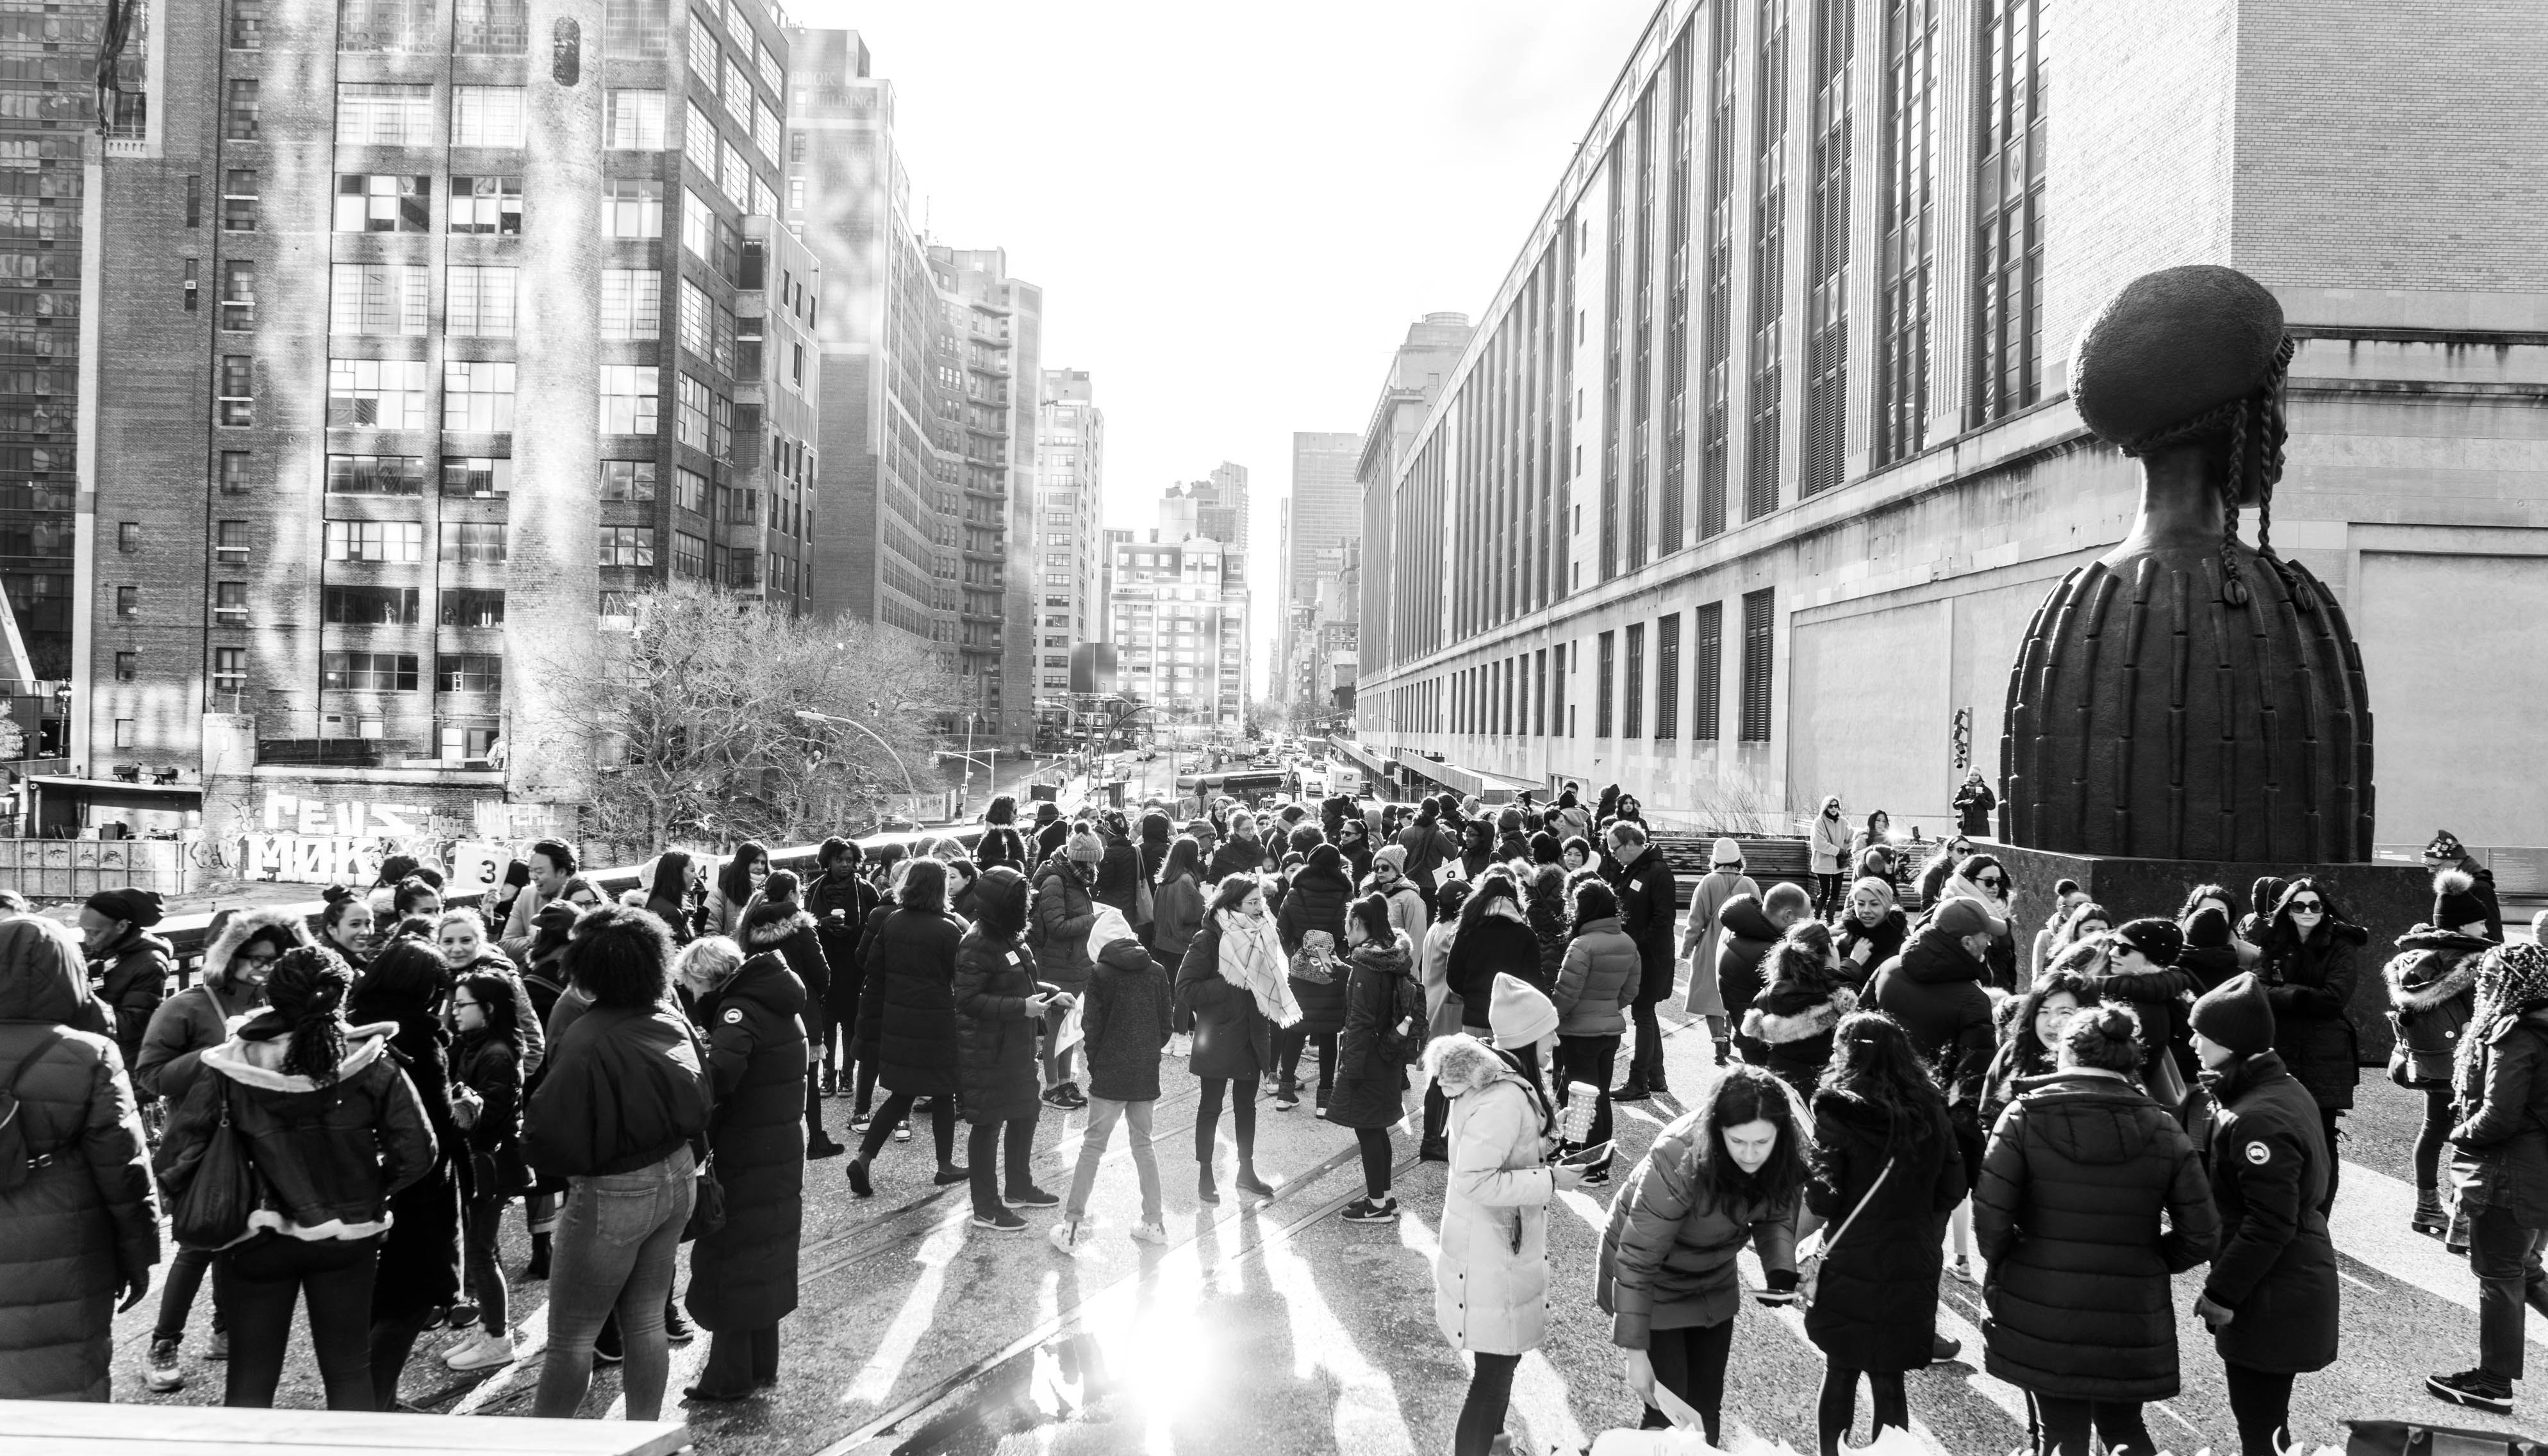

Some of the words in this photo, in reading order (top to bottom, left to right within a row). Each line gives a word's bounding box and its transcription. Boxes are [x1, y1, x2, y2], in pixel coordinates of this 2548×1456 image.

[791, 71, 836, 87] BOOK
[807, 94, 874, 109] BUILDING
[480, 859, 496, 884] 3
[698, 864, 708, 884] 4
